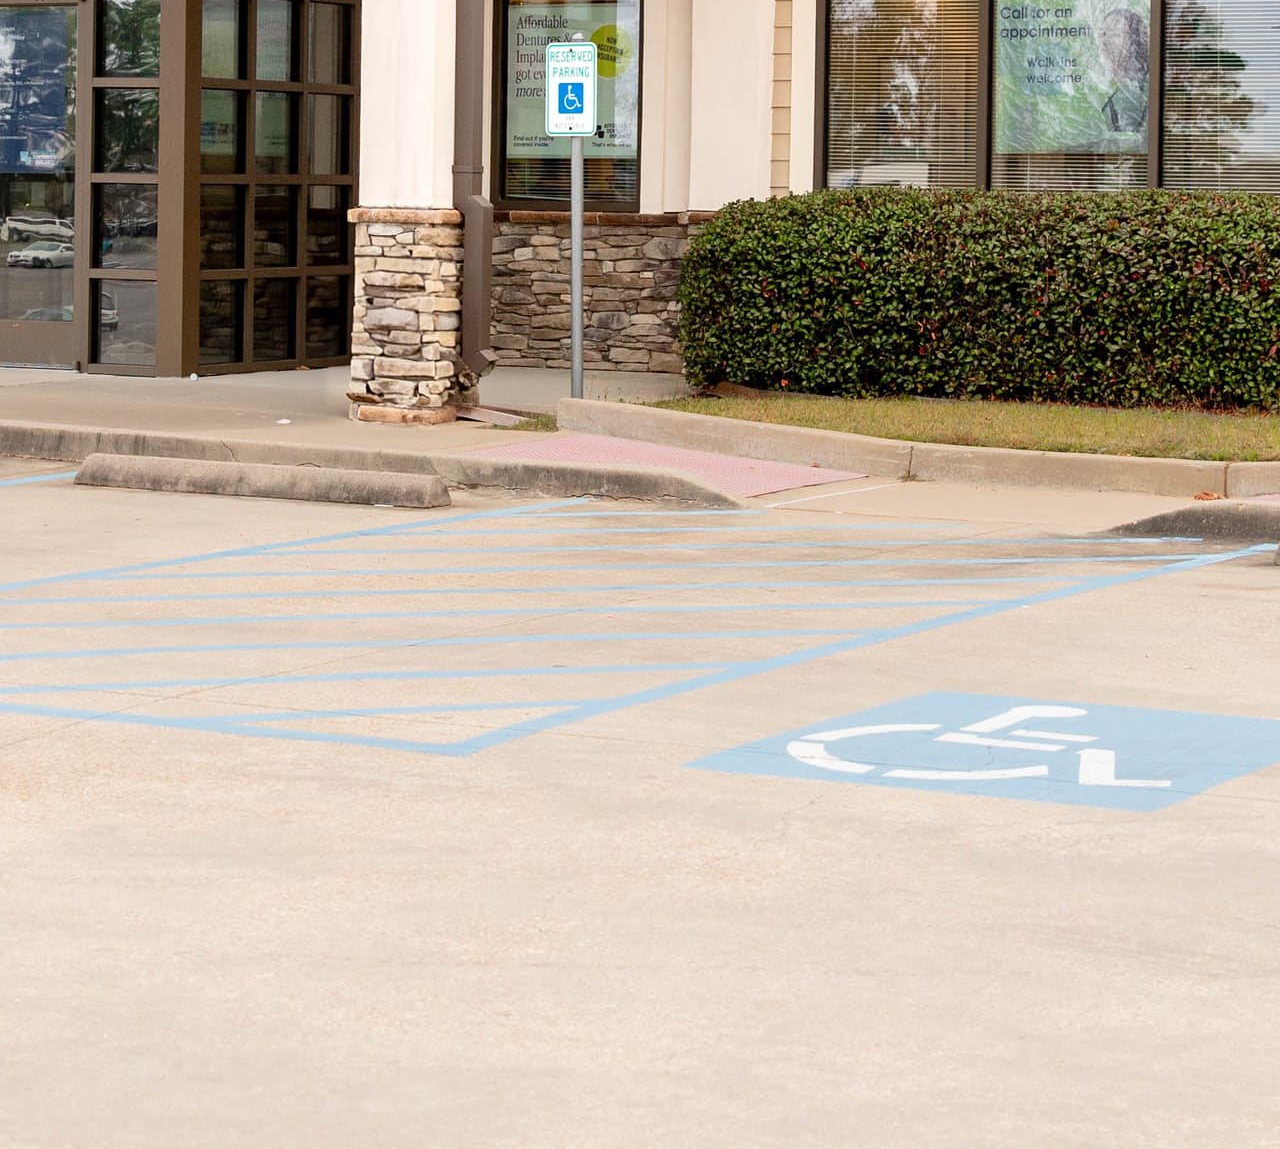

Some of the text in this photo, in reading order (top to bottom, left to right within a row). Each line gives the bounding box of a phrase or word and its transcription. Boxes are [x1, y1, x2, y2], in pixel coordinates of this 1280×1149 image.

[1000, 6, 1028, 20] Call
[1055, 7, 1073, 19] an
[516, 14, 569, 30] Affordable
[1000, 25, 1091, 40] appointment
[516, 33, 560, 46] Dentures
[550, 50, 593, 62] RESERVED
[515, 69, 532, 84] got
[552, 67, 590, 78] PARKING
[1027, 73, 1081, 83] welcome
[516, 87, 543, 98] more
